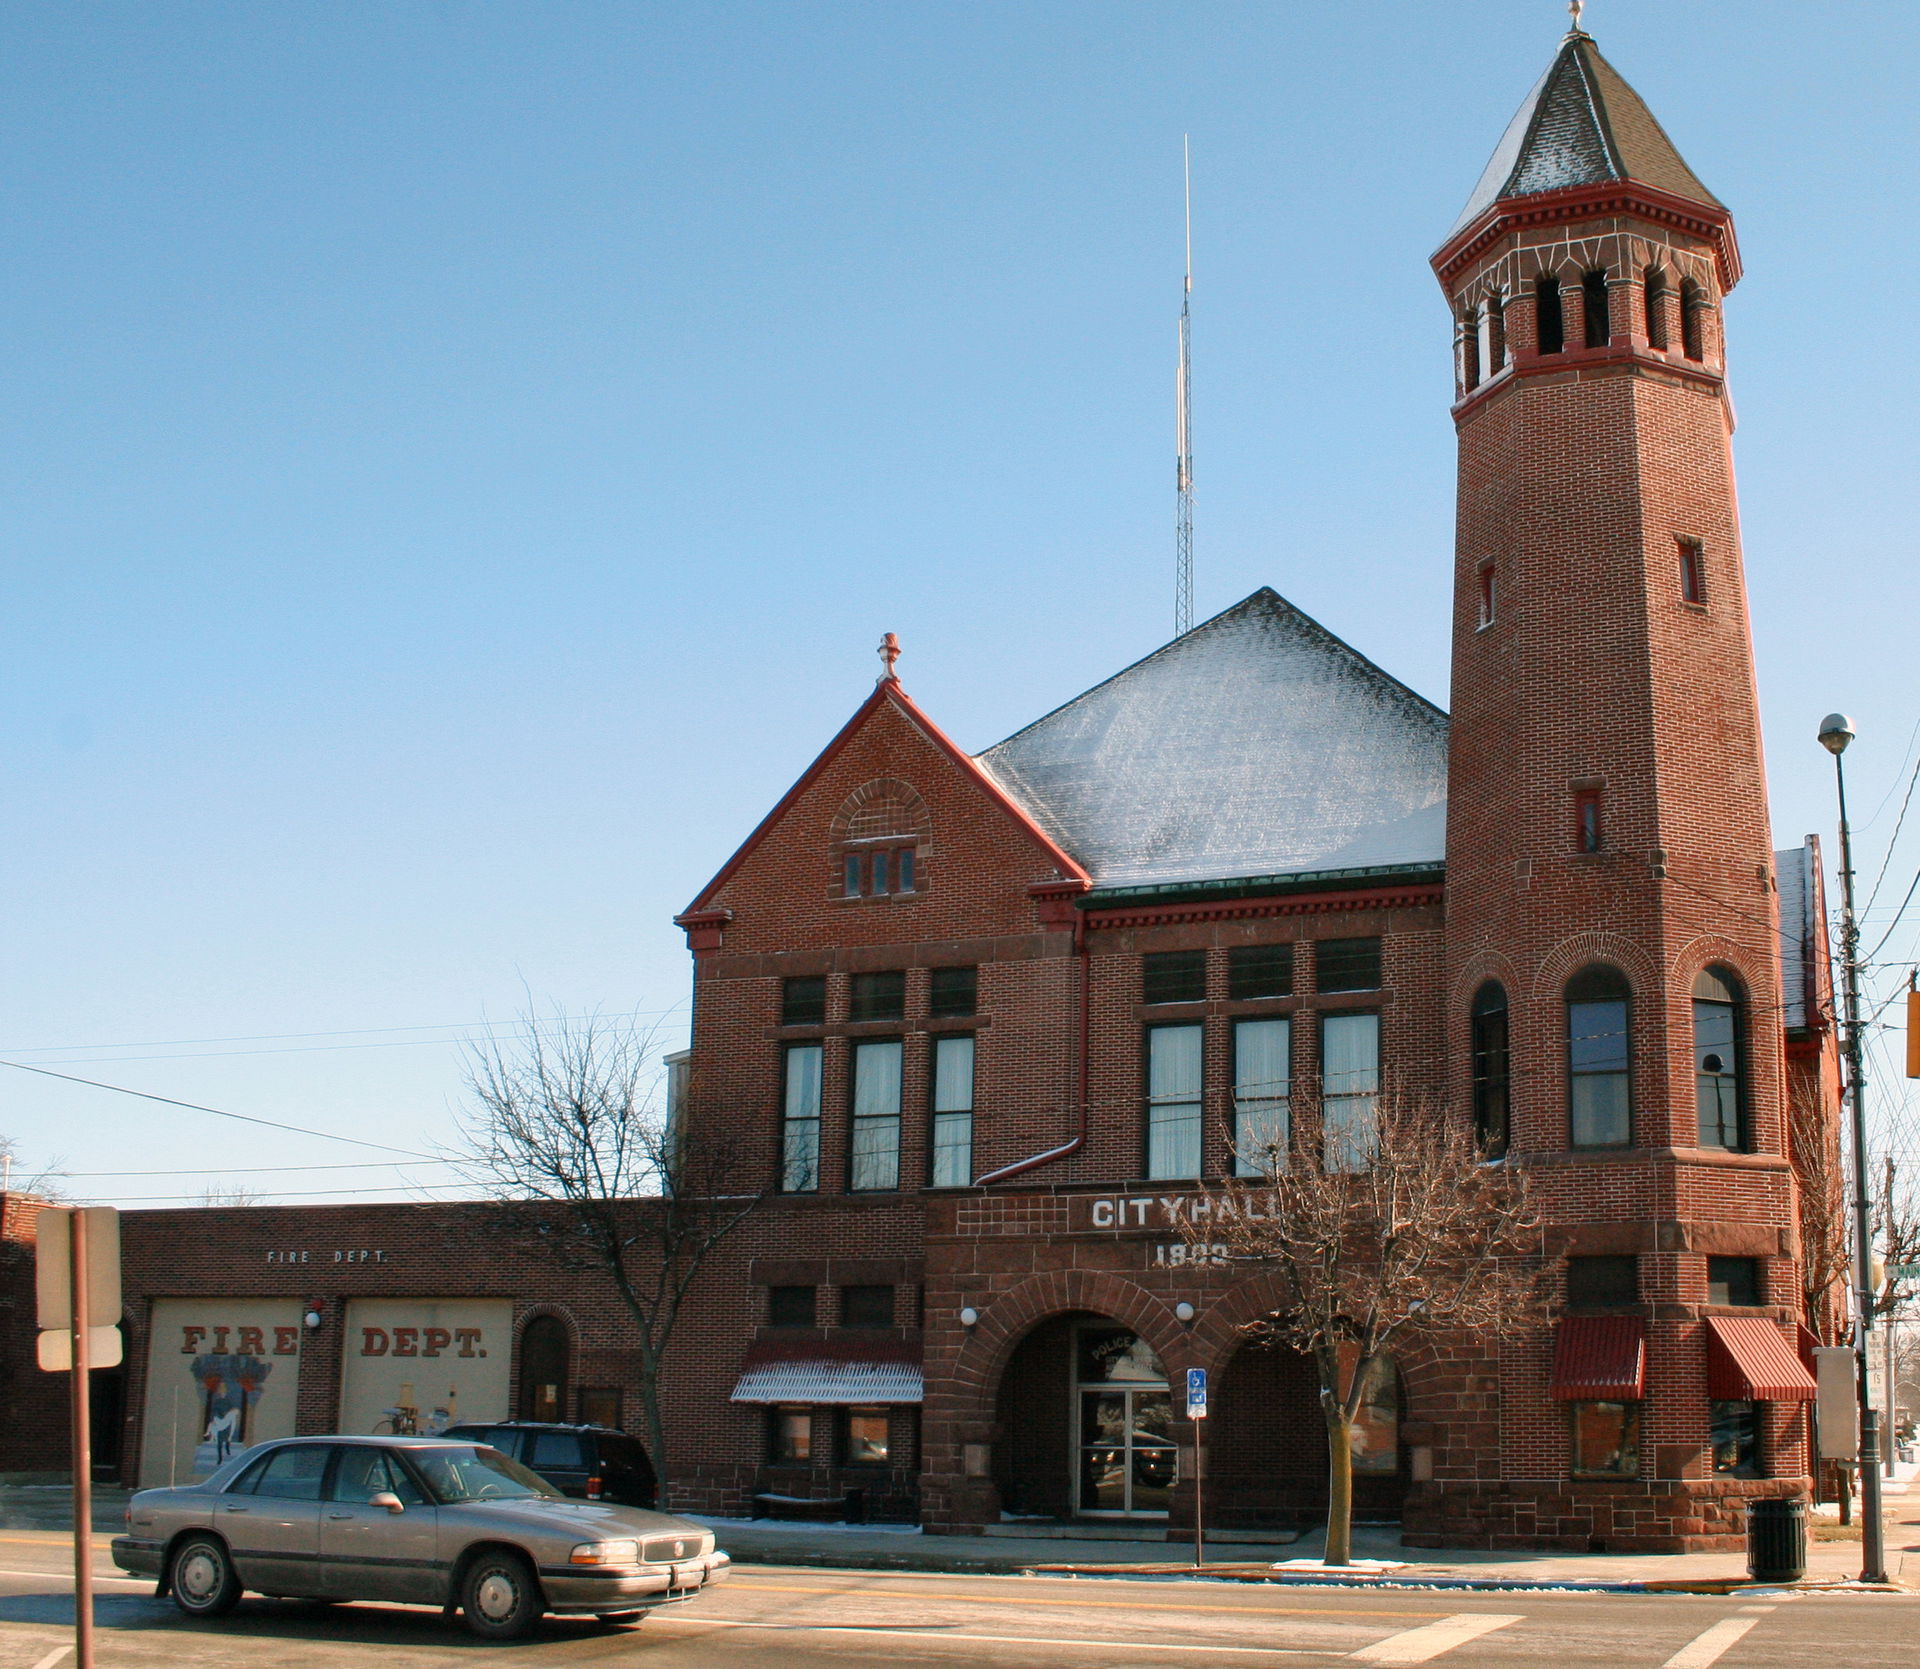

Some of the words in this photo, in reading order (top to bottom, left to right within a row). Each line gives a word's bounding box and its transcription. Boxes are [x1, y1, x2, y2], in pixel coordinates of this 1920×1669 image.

[1092, 1197, 1185, 1227] CITY
[1190, 1194, 1295, 1224] HALL
[267, 1251, 309, 1263] FIRE
[334, 1250, 388, 1263] DEPT.
[181, 1326, 299, 1356] FIRE
[361, 1327, 487, 1358] DEPT.
[1092, 1336, 1131, 1360] POLICE
